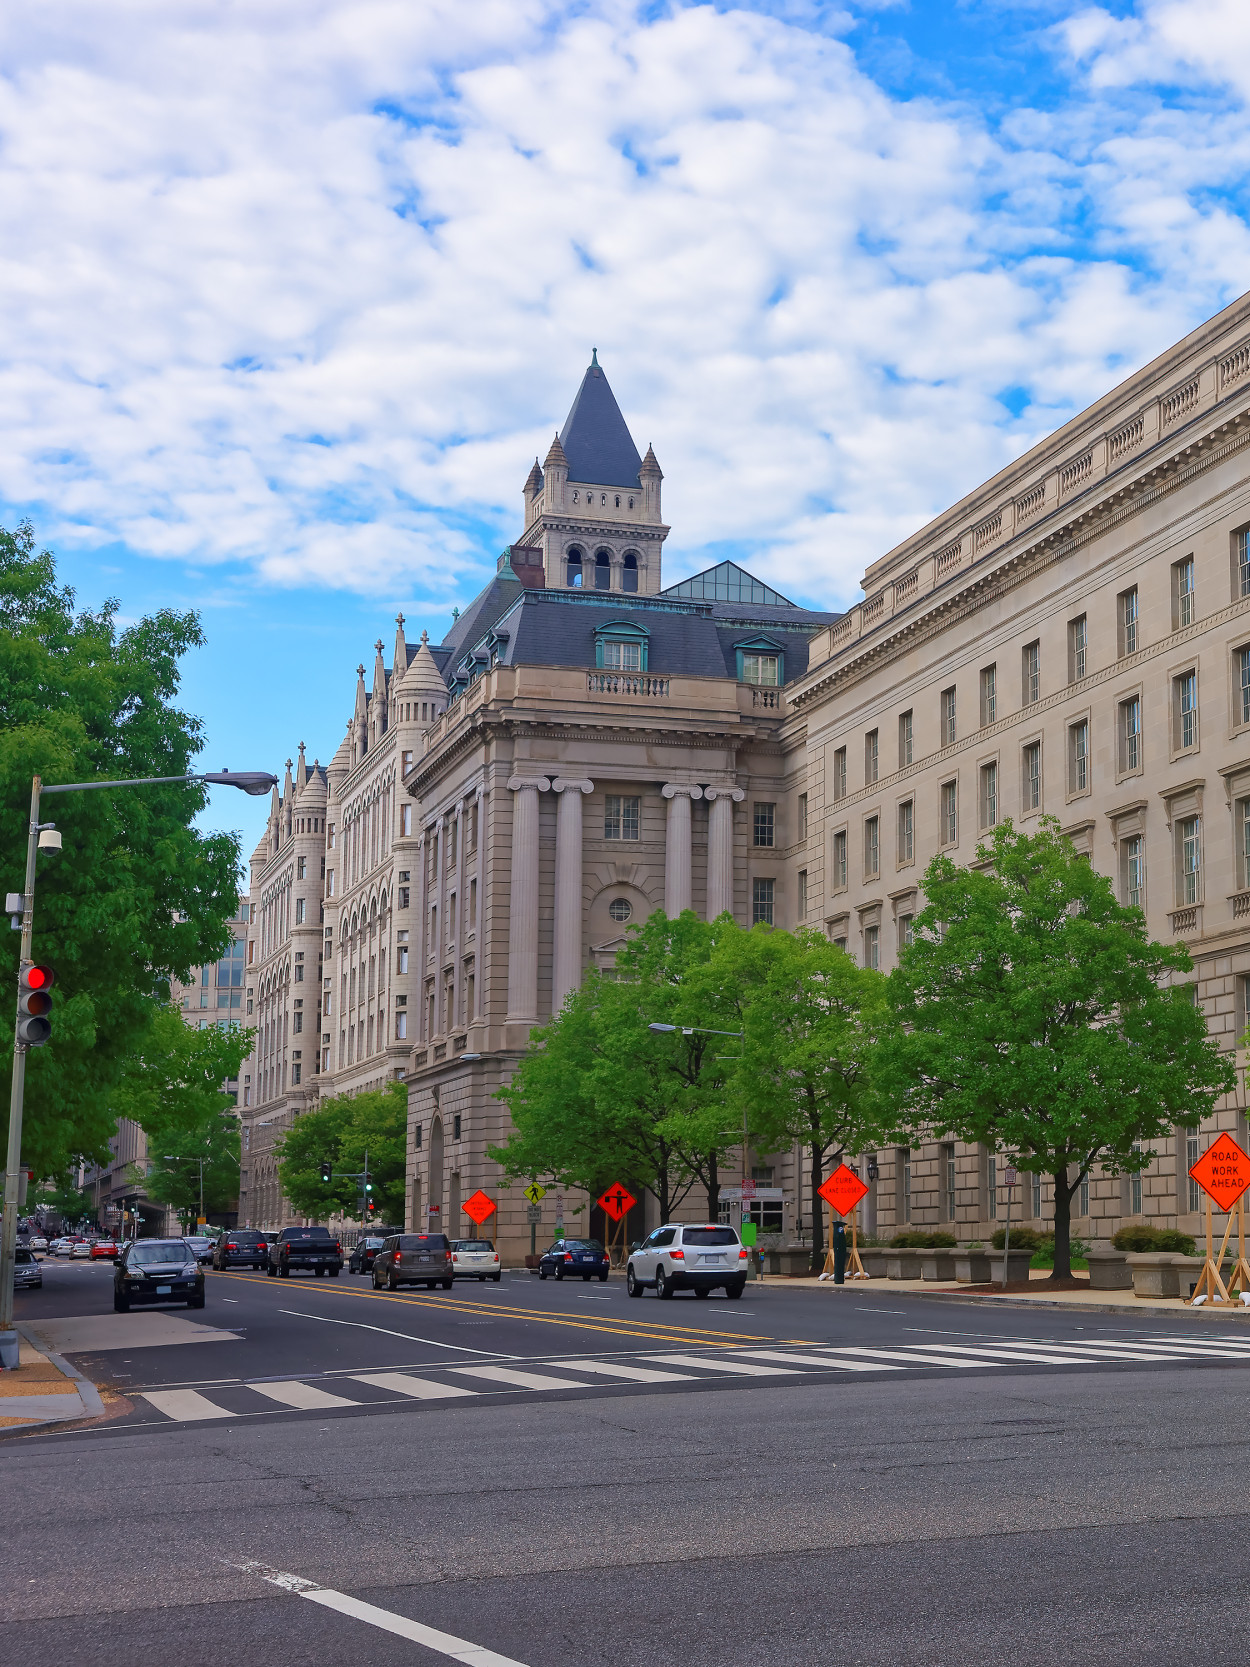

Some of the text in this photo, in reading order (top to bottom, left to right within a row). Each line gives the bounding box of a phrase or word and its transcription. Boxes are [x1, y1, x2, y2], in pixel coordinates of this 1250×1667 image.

[1211, 1151, 1239, 1161] ROAD
[1211, 1166, 1239, 1175] WORK
[1211, 1178, 1244, 1187] AHEAD
